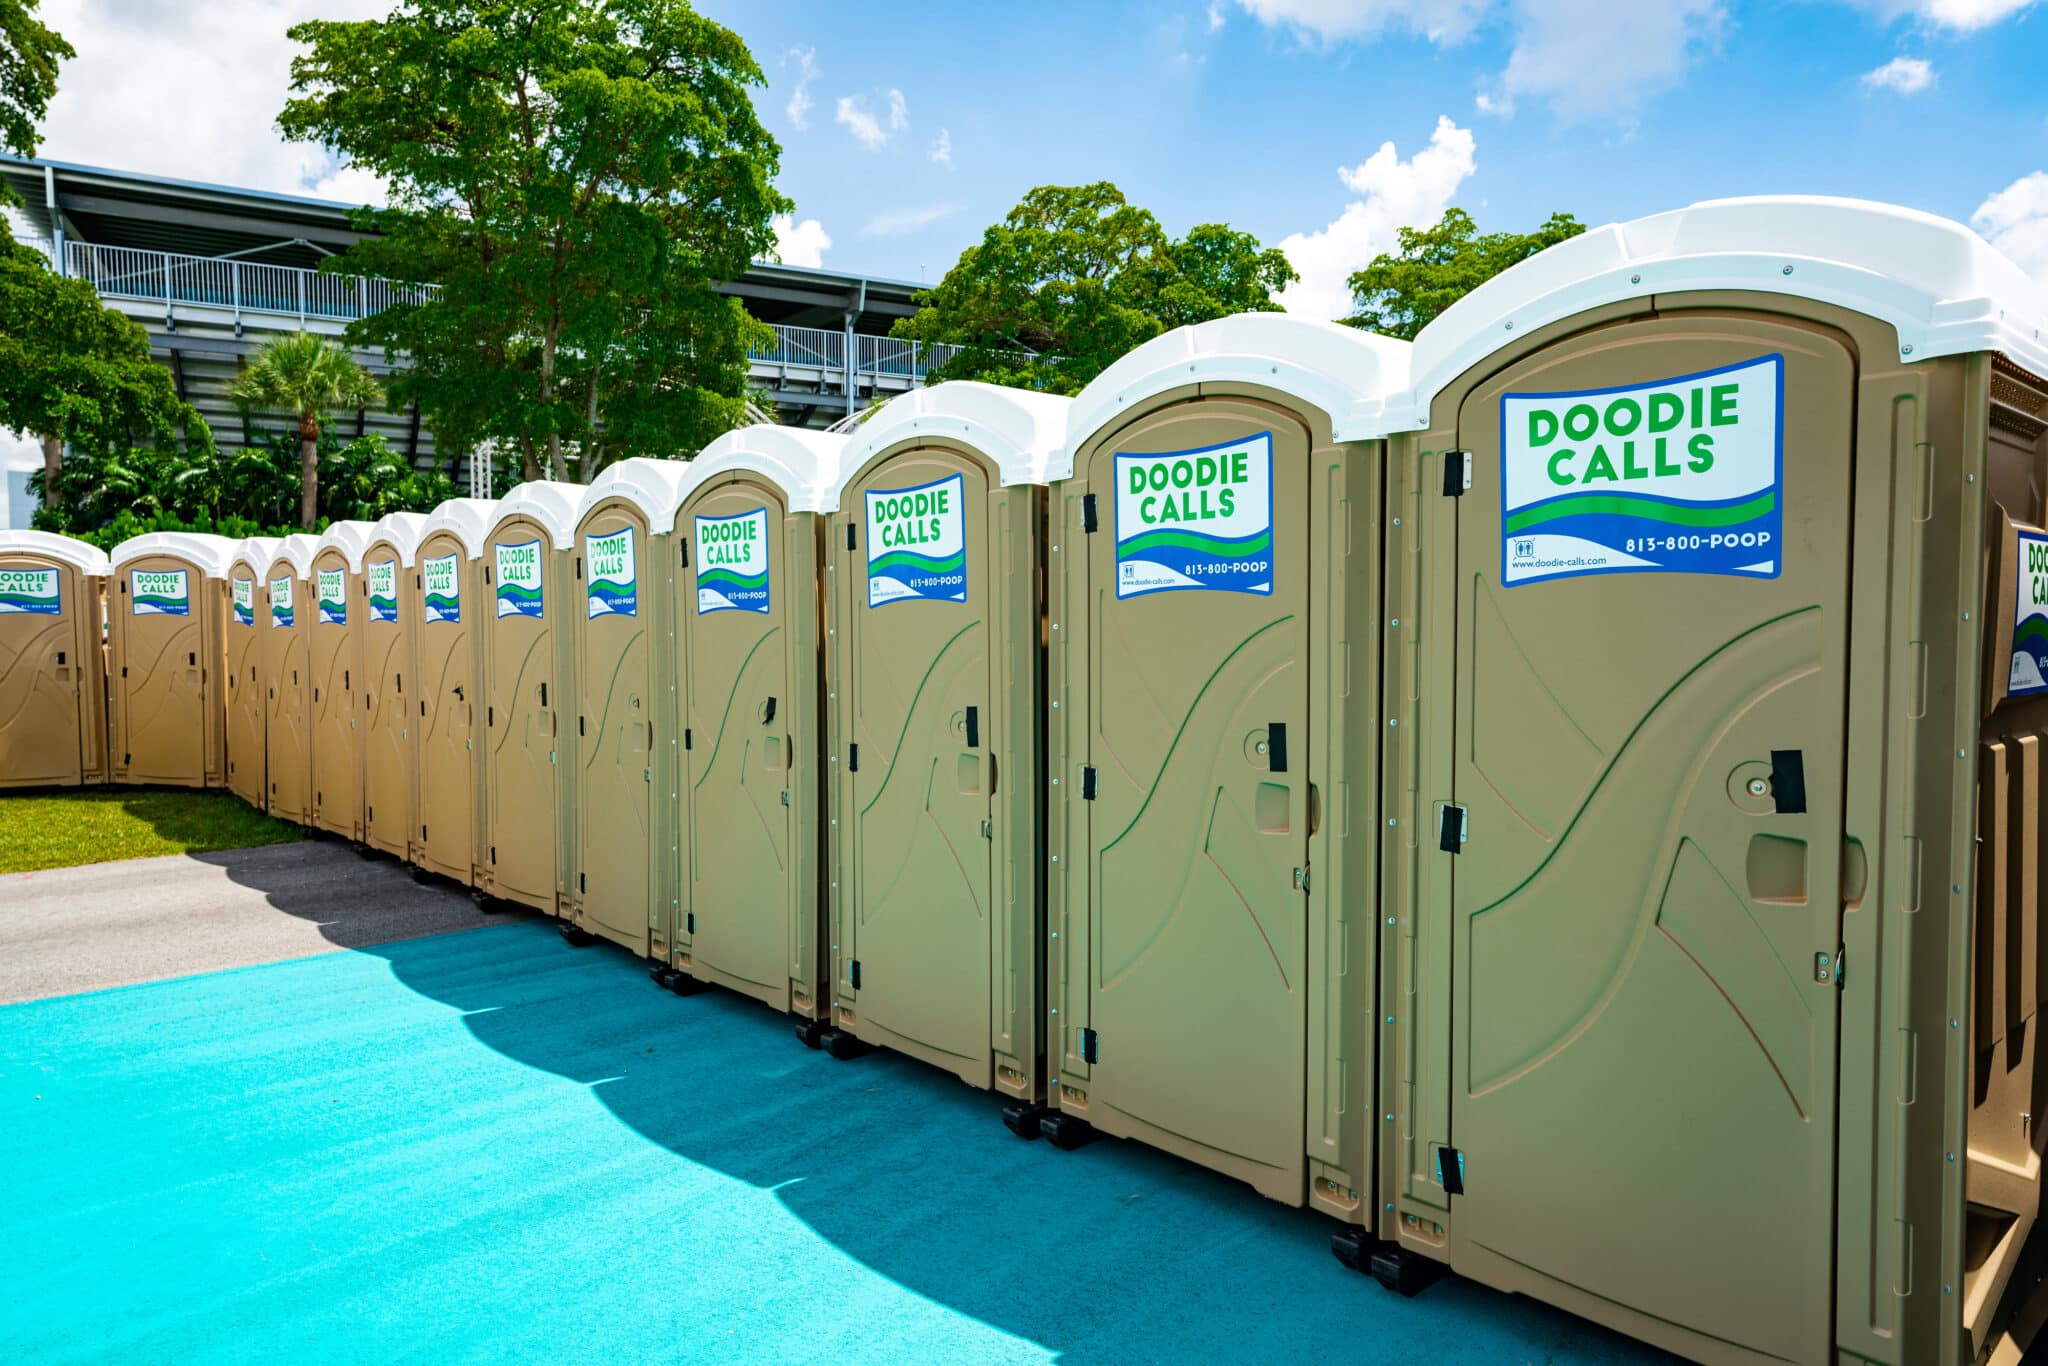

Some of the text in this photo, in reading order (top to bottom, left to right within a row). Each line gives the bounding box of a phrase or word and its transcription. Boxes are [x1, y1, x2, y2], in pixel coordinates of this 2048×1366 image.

[1528, 383, 1739, 448] DOODIE
[1546, 433, 1715, 486] CALLS
[1129, 452, 1248, 494] DOODIE
[875, 489, 949, 523] DOODIE
[1140, 488, 1235, 524] CALLS
[701, 520, 757, 544] DOODIE
[882, 518, 941, 547] CALLS
[1625, 532, 1771, 553] 813-800-POOP
[499, 548, 535, 565] DOODIE
[590, 537, 627, 558] DOODIE
[707, 543, 751, 565] CALLS
[503, 565, 532, 580] CALLS
[594, 557, 623, 576] CALLS
[1185, 561, 1268, 575] 813-800-POOP
[1512, 557, 1607, 569] www.doodie-calls.com
[0, 573, 48, 582] OODIE
[137, 574, 180, 583] DOODIE
[910, 575, 963, 587] 813-800-POOP
[141, 584, 176, 593] CALLS
